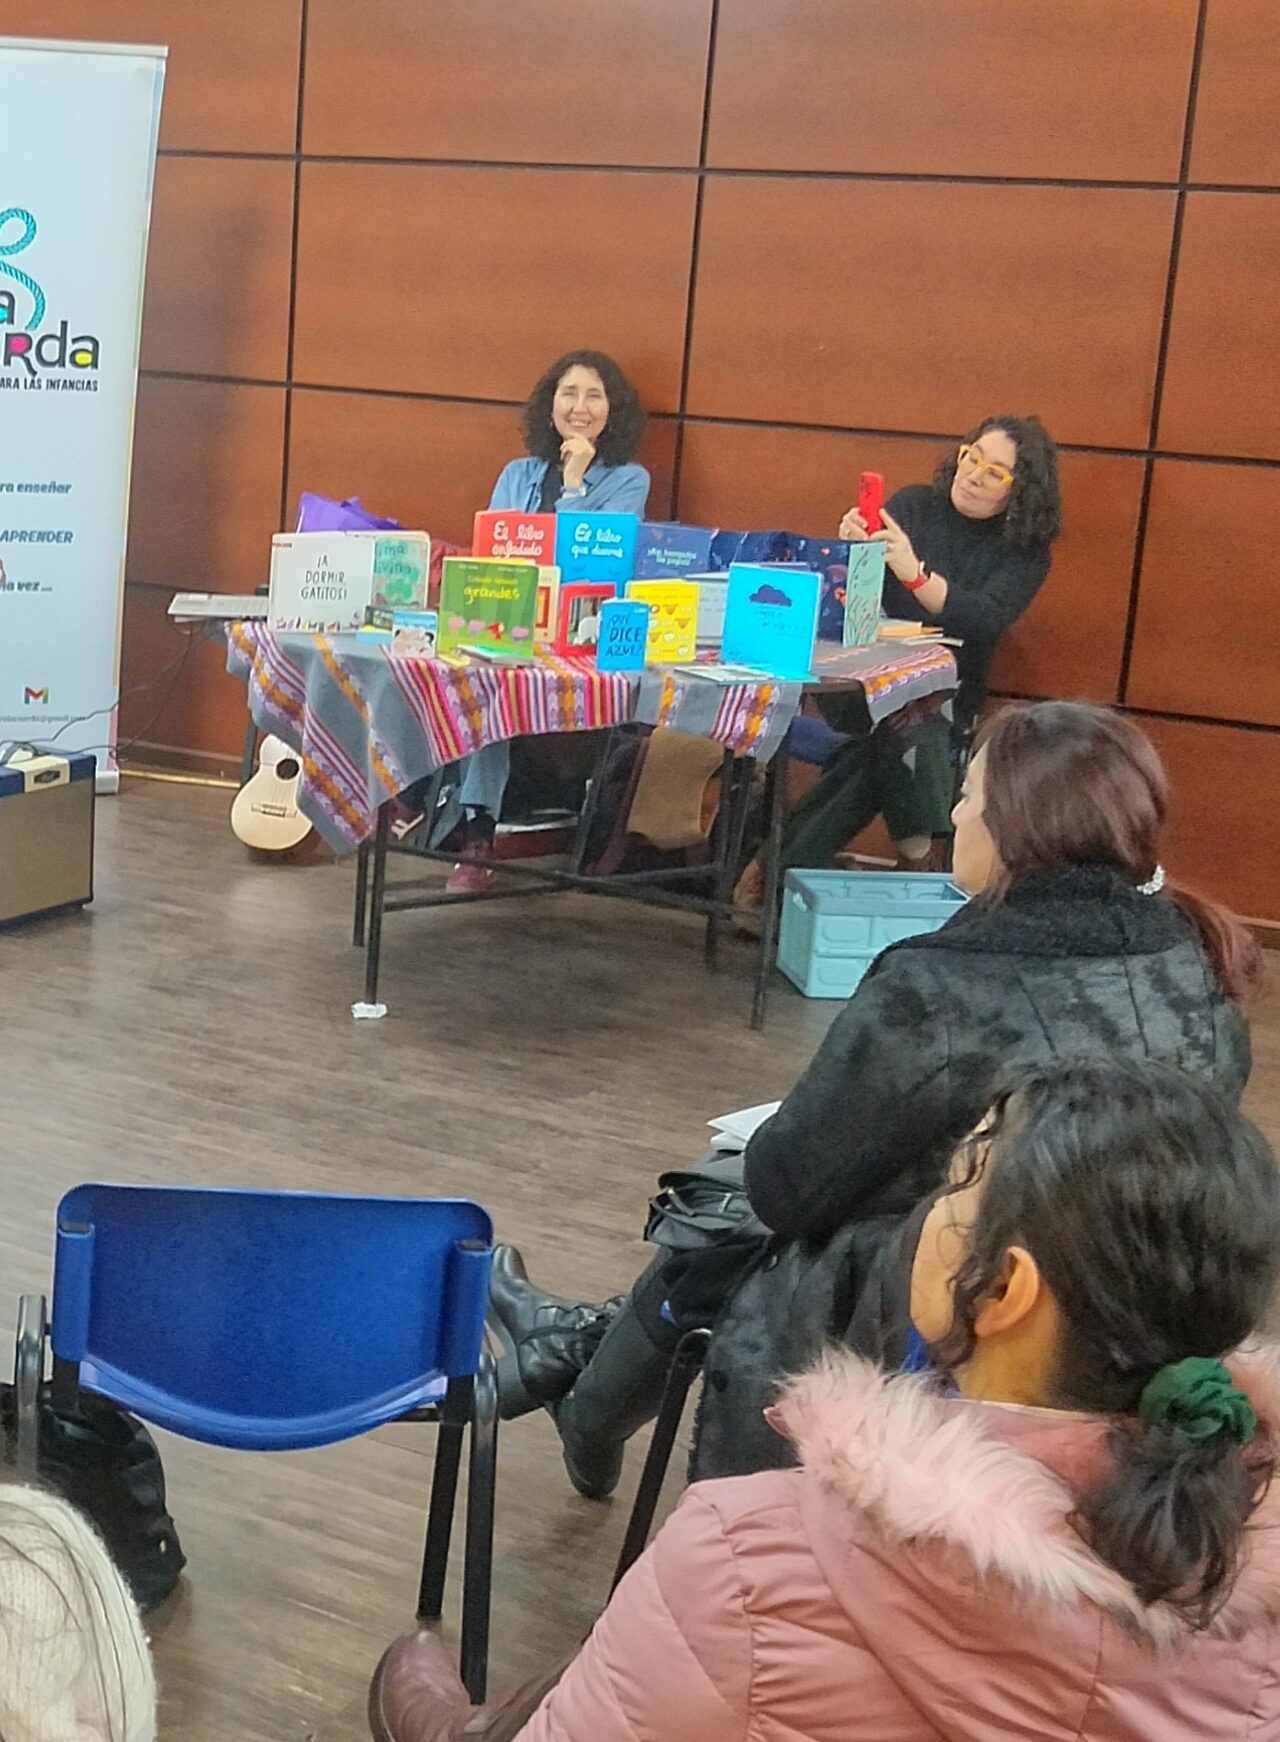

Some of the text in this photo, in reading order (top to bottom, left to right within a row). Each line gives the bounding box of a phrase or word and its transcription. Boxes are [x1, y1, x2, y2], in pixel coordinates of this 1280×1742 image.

[23, 377, 42, 390] LAS
[45, 378, 99, 392] INFANCIAS
[17, 480, 73, 494] enseñar
[0, 529, 74, 544] APRENDER
[494, 520, 544, 541] El libro
[574, 522, 623, 544] El libro
[609, 627, 641, 643] DICE
